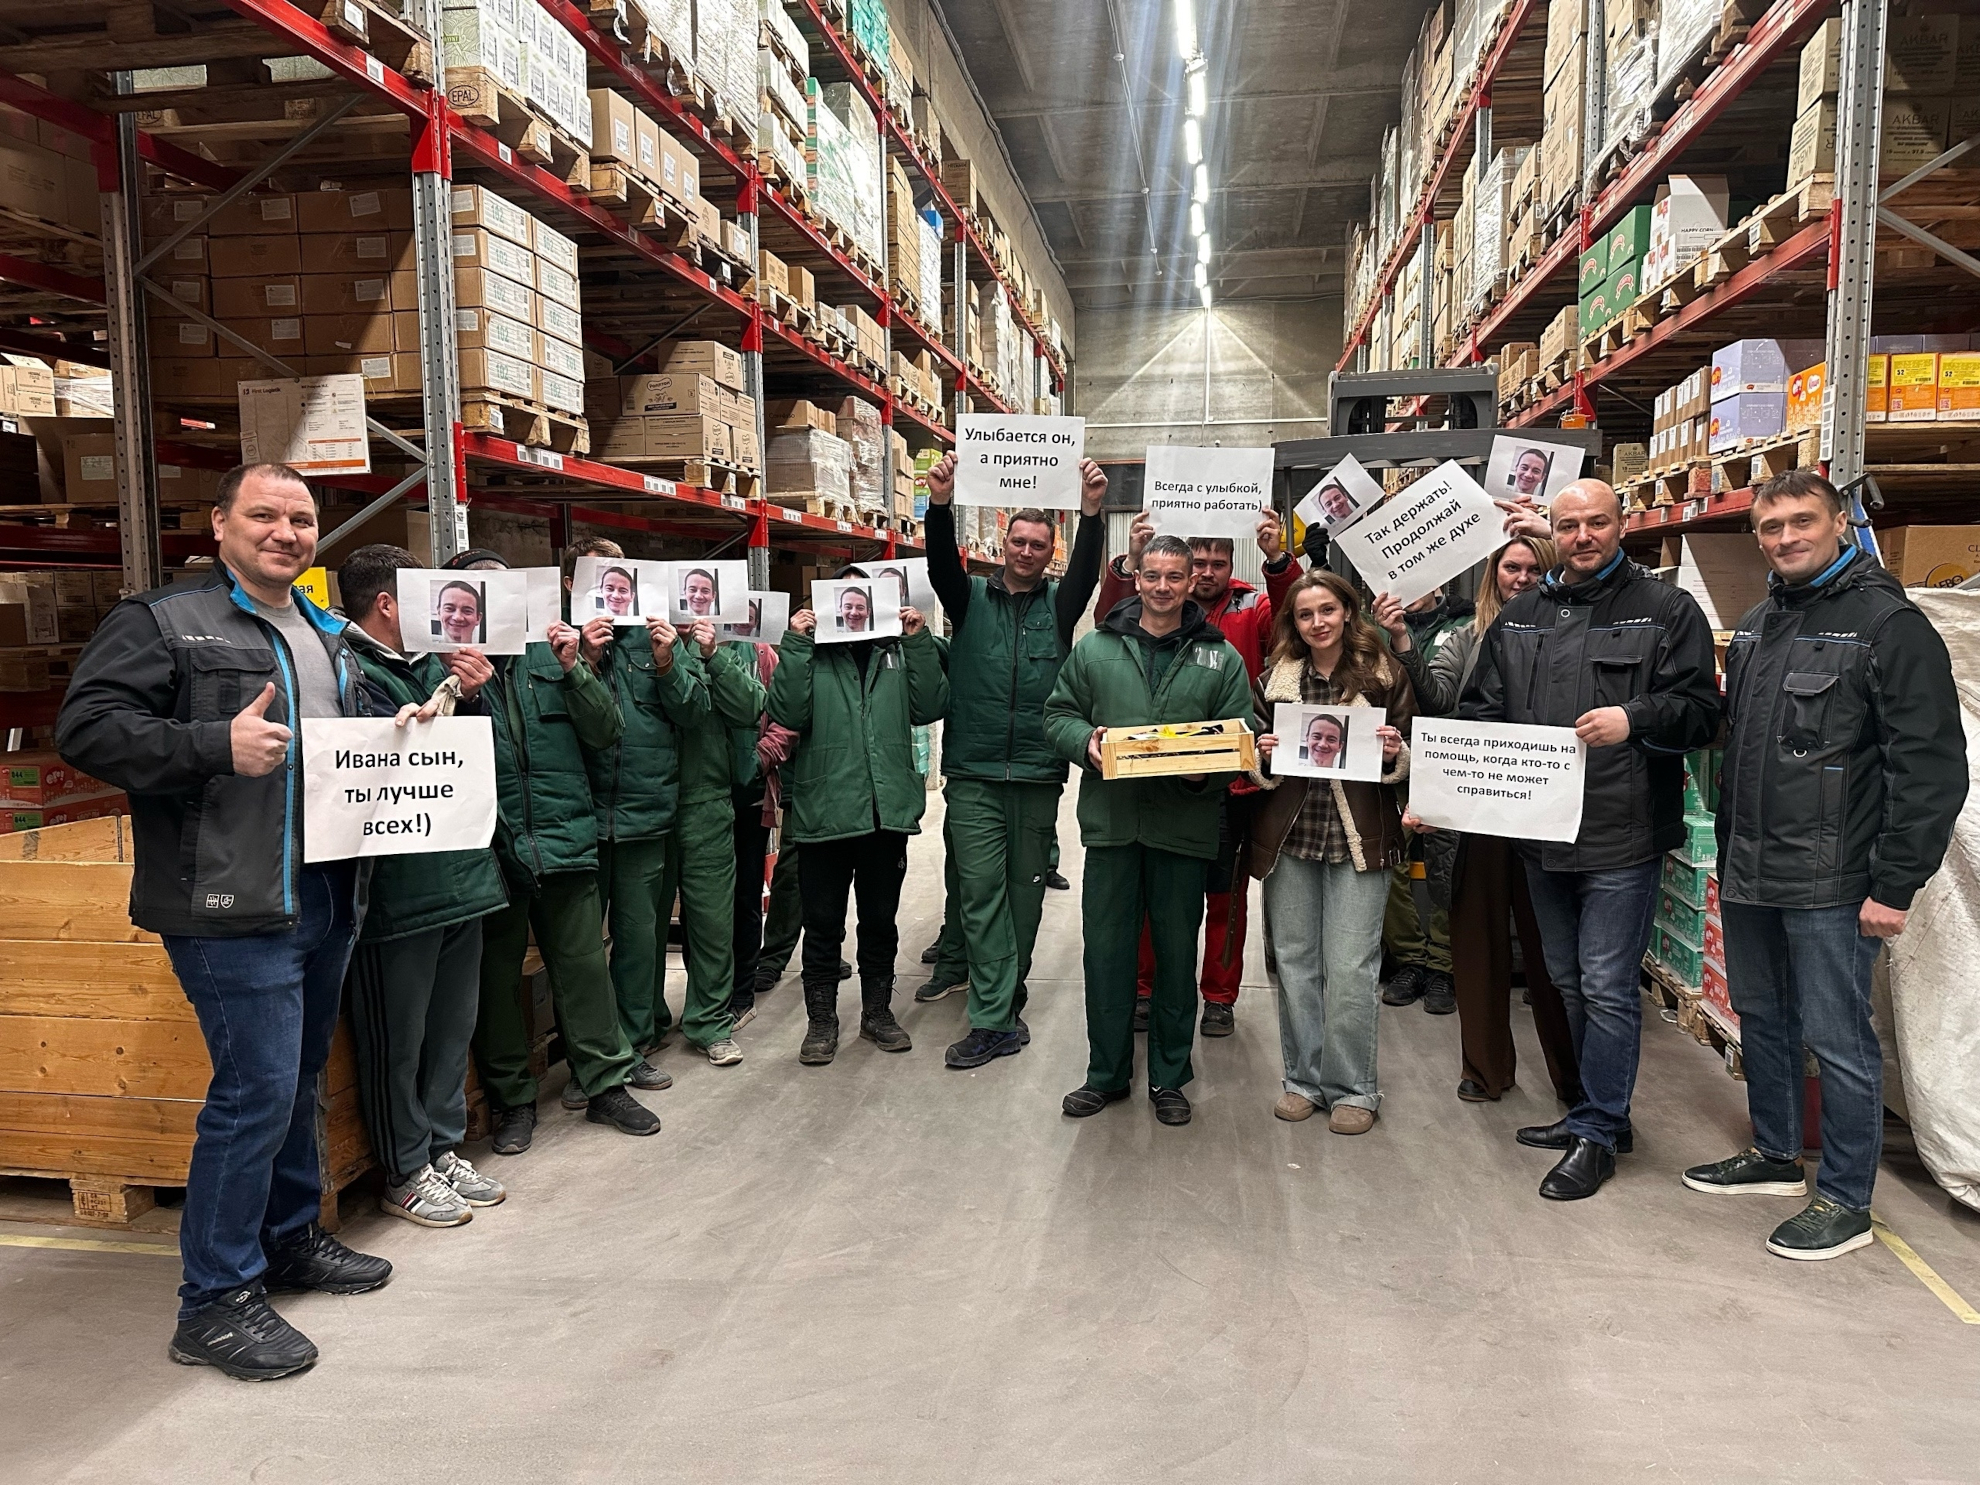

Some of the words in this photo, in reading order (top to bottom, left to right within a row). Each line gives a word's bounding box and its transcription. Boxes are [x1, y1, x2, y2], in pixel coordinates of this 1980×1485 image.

[452, 90, 474, 102] EPAL
[1892, 114, 1940, 125] AKBAR
[965, 428, 1046, 443] Улыбается
[1051, 434, 1076, 447] он,
[980, 454, 988, 464] а
[993, 454, 1059, 468] приятно
[999, 475, 1037, 489] мне!
[1154, 481, 1194, 494] Всегда
[1197, 484, 1203, 493] с
[1206, 482, 1262, 495] улыбкой,
[1151, 500, 1201, 510] приятно
[1204, 499, 1263, 513] работать)
[1364, 525, 1391, 545] Так
[1392, 480, 1453, 530] держать!
[1381, 498, 1463, 559] Продолжай
[1387, 570, 1398, 581] в
[1397, 551, 1426, 574] том
[1426, 536, 1447, 555] же
[1449, 512, 1481, 542] духе
[299, 585, 313, 594] ая
[1421, 732, 1437, 743] Ты
[1440, 736, 1480, 747] всегда
[1483, 738, 1557, 753] приходишь
[1561, 744, 1576, 754] на
[335, 750, 400, 769] Ивана
[408, 751, 464, 768] сын,
[1425, 750, 1479, 764] помощь,
[1483, 755, 1518, 767] когда
[1521, 758, 1560, 770] кто-то
[1564, 761, 1571, 770] с
[1442, 768, 1485, 779] чем-то
[1488, 771, 1503, 781] не
[1506, 774, 1549, 785] может
[345, 788, 371, 803] ты
[376, 784, 453, 805] лучше
[1457, 784, 1532, 800] справиться!
[363, 813, 432, 837] всех!)
